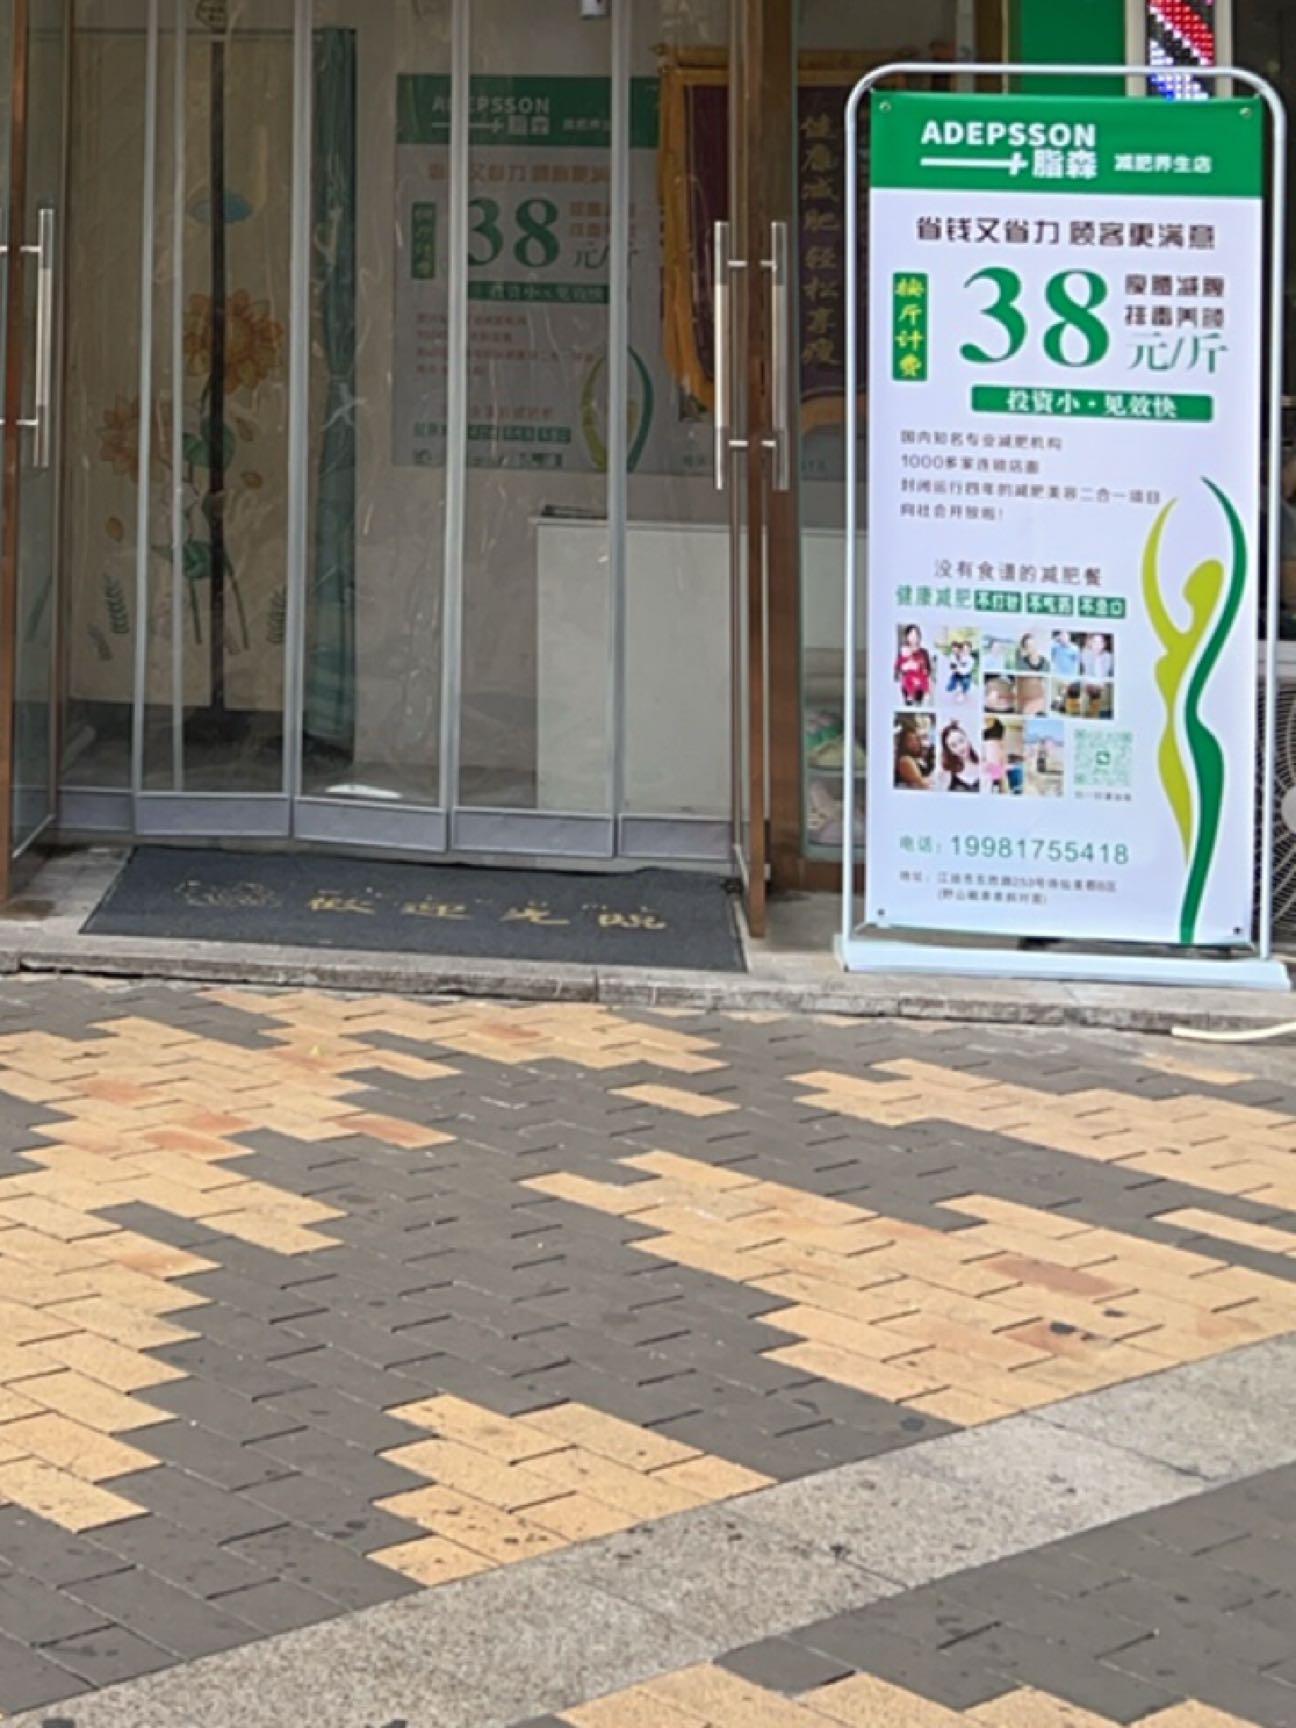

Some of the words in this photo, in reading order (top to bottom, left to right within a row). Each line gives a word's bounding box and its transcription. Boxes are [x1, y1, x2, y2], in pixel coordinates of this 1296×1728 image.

[920, 120, 1097, 148] ADEPSSON
[1031, 149, 1098, 179] 脂森
[1114, 153, 1212, 174] 减肥养生店
[916, 216, 1060, 244] 省钱又省力
[959, 266, 1110, 368] 38
[1128, 330, 1229, 374] 元/斤
